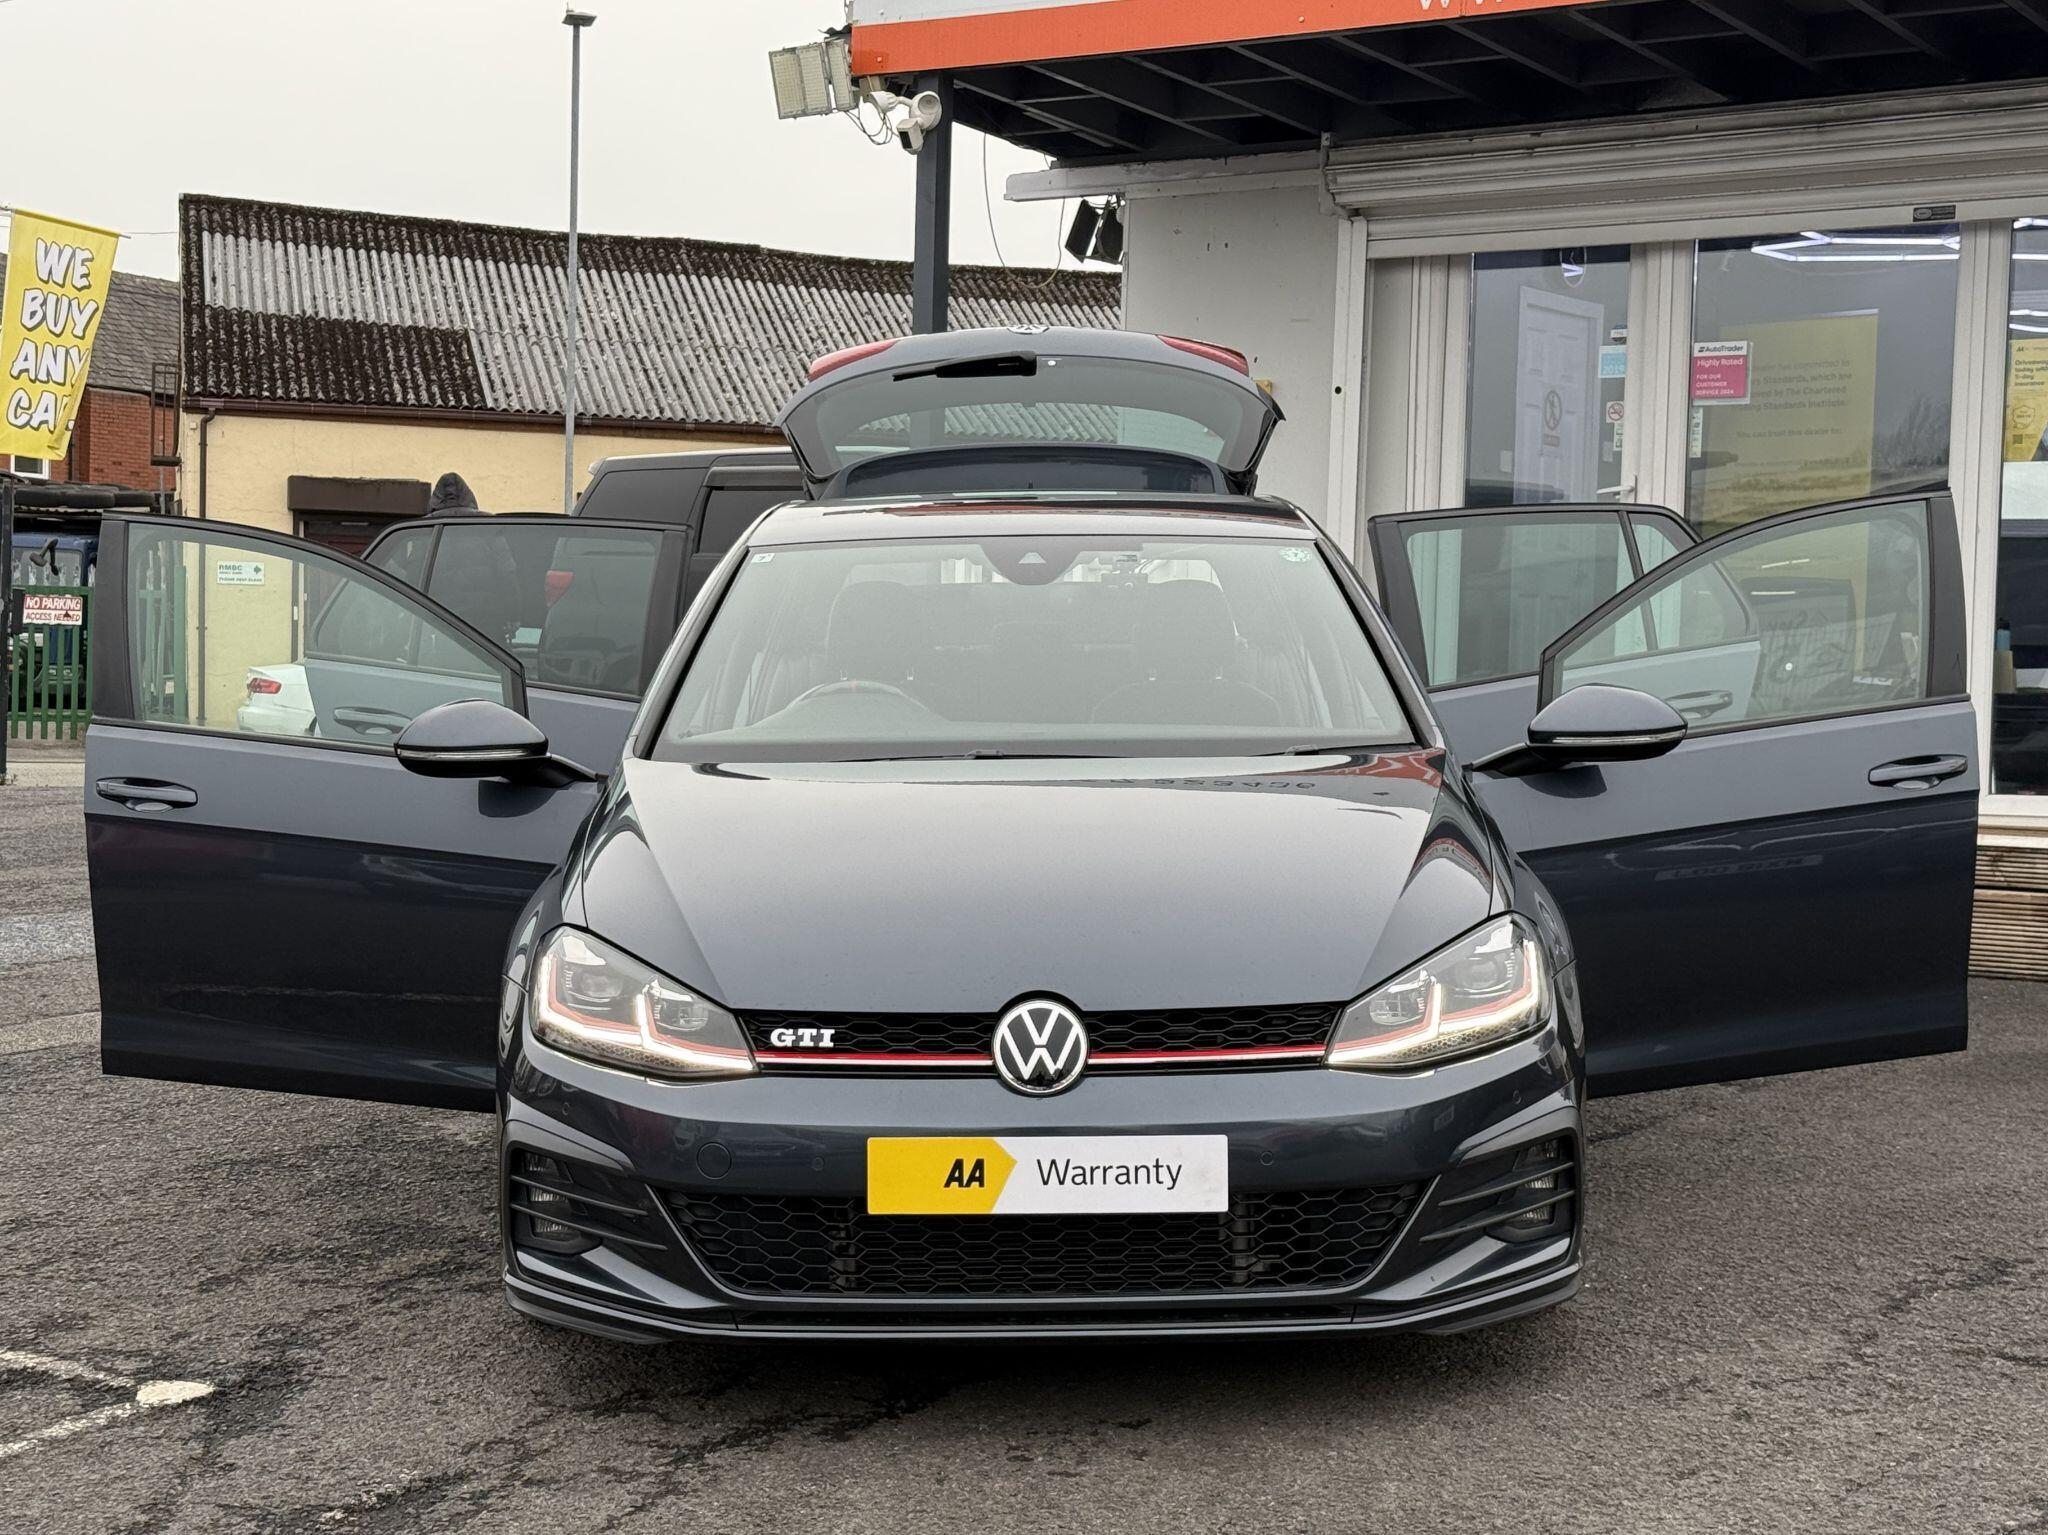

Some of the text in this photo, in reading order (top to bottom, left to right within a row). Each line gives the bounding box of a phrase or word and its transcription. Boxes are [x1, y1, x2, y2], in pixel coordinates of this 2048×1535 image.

[35, 237, 94, 292] WE
[19, 288, 99, 340] BUY
[1696, 357, 1744, 368] Highly Rated
[1810, 372, 1837, 383] which
[1803, 385, 1847, 395] Chartered
[26, 596, 81, 610] NO PARKING
[25, 611, 52, 621] ACCESS
[770, 1027, 836, 1048] GTI
[943, 1157, 1182, 1190] AA Warranty
